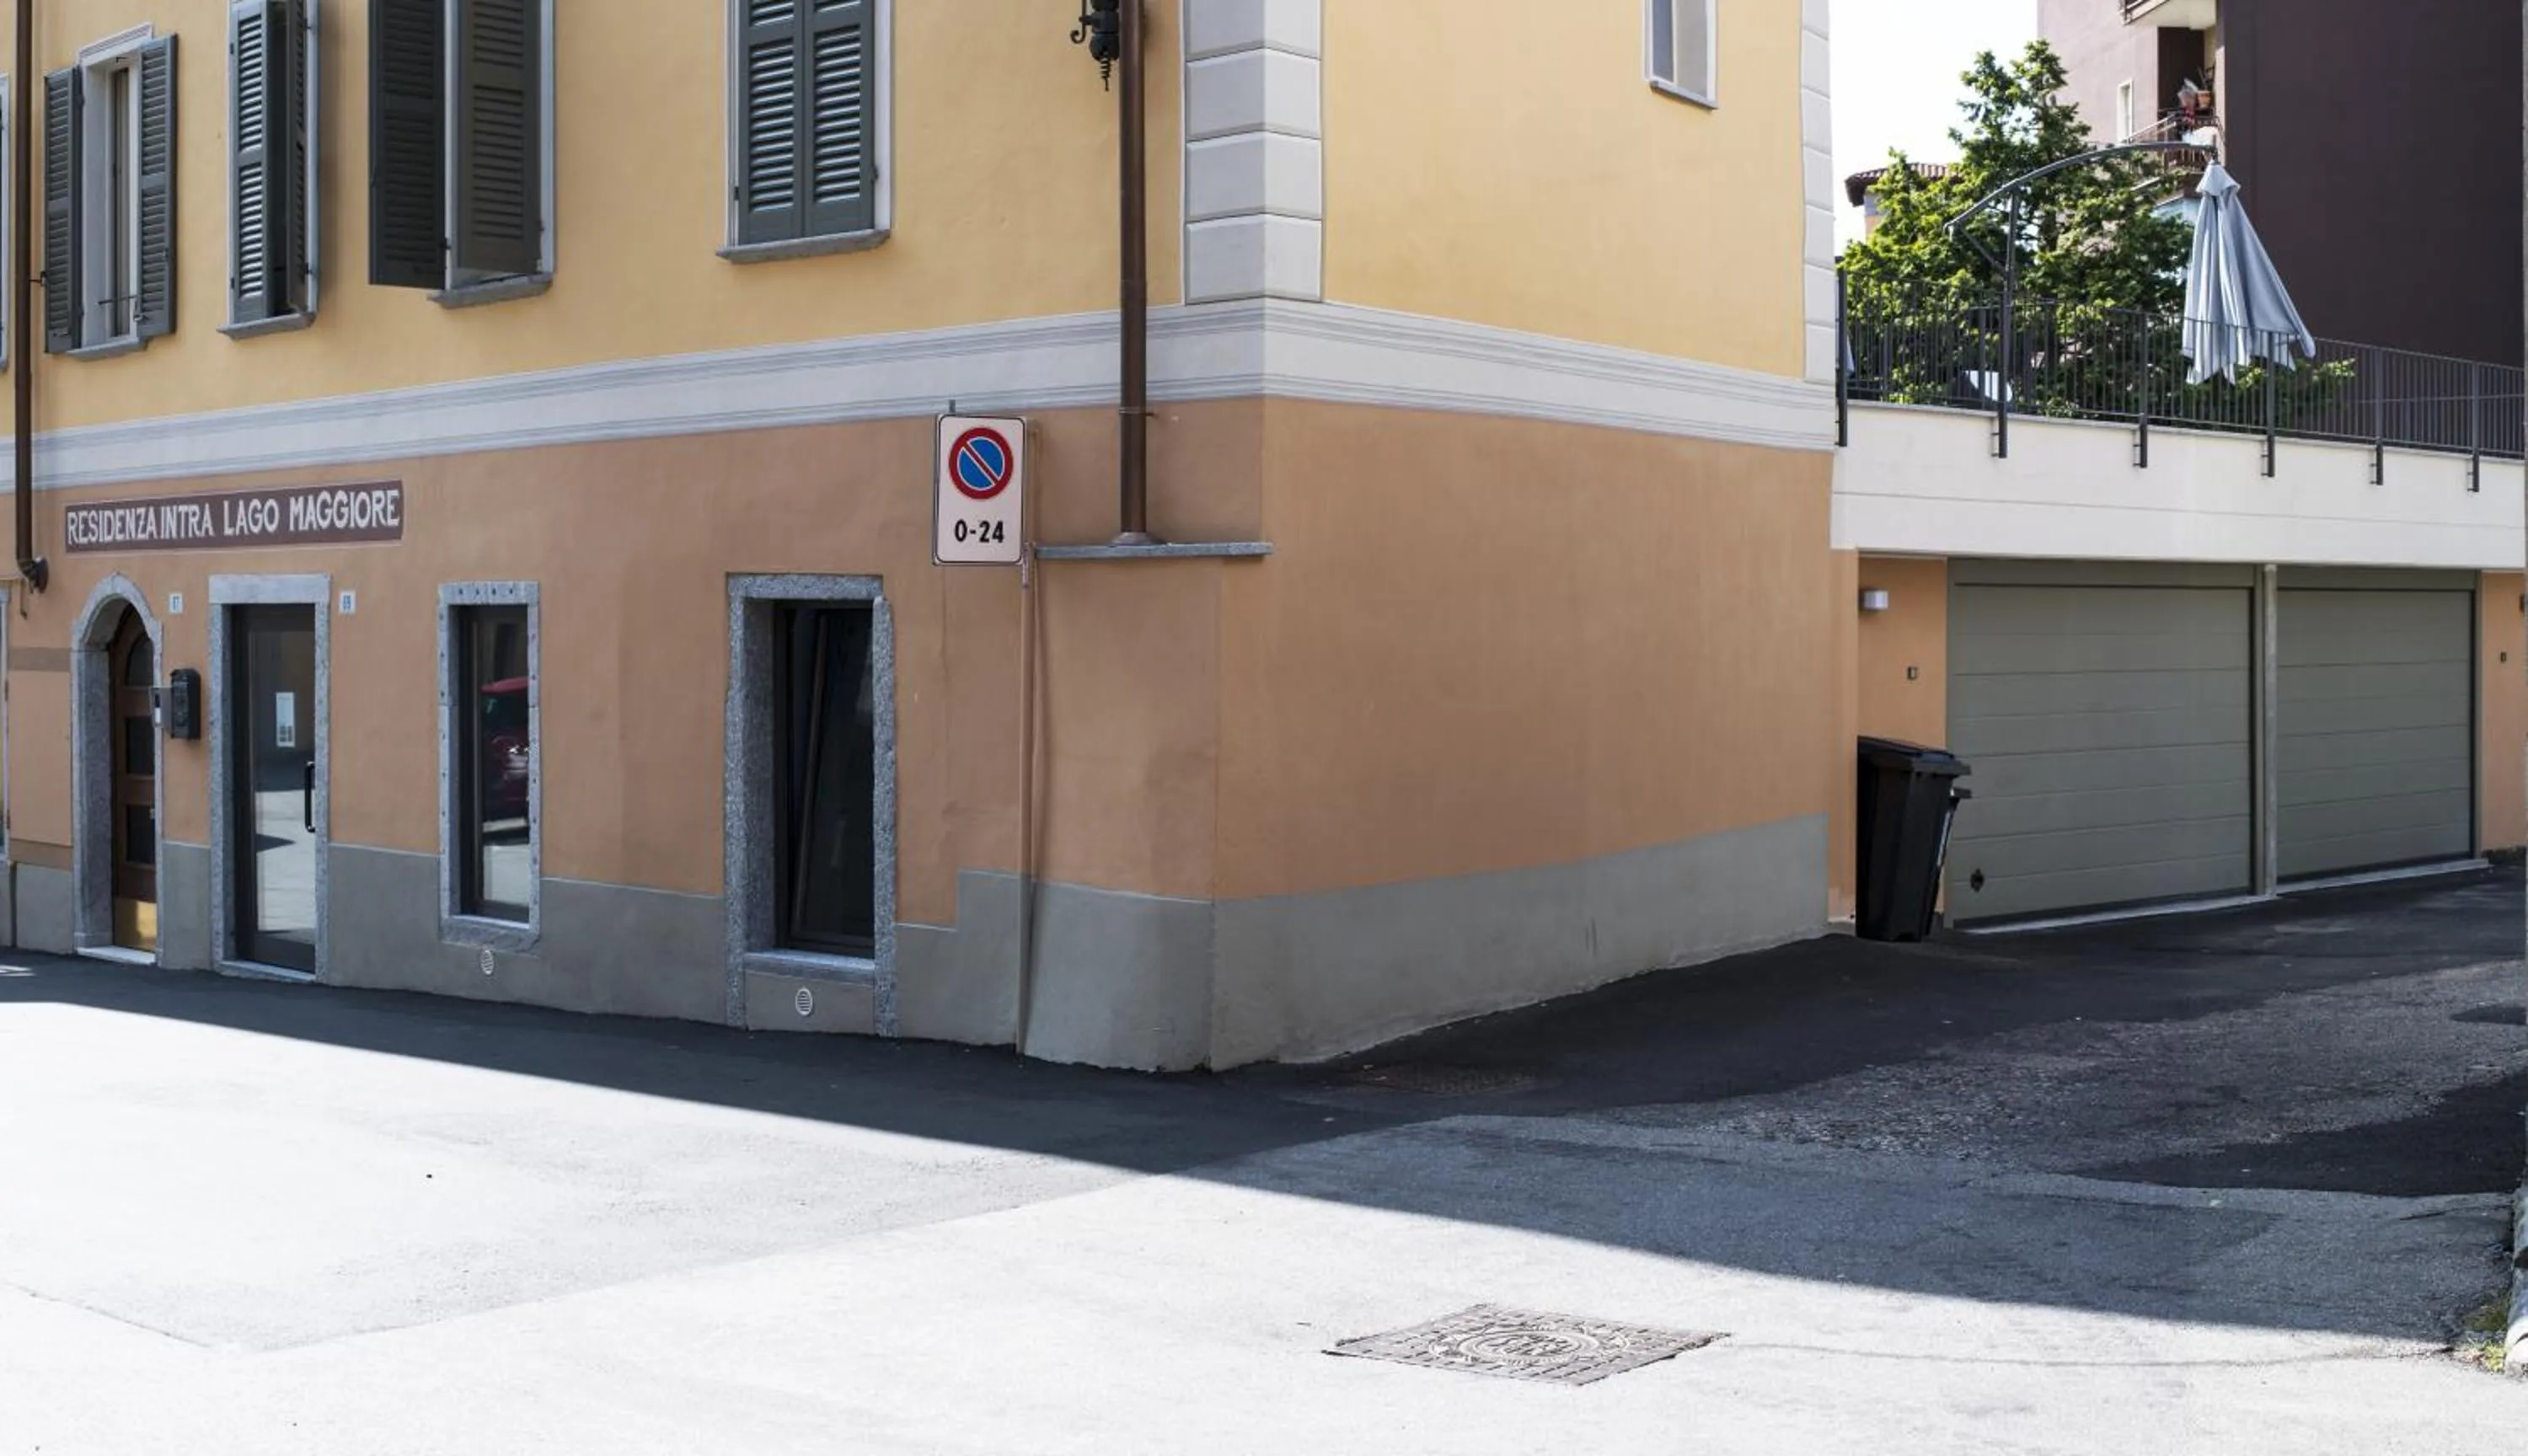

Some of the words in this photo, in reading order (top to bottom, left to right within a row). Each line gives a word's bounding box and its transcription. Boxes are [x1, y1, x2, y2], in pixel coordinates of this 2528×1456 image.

[67, 506, 158, 545] RESIDENZA
[161, 502, 215, 539] INTRA
[222, 499, 280, 536] LAGO
[289, 490, 400, 532] MAGGIORE
[954, 519, 1004, 543] 0-24
